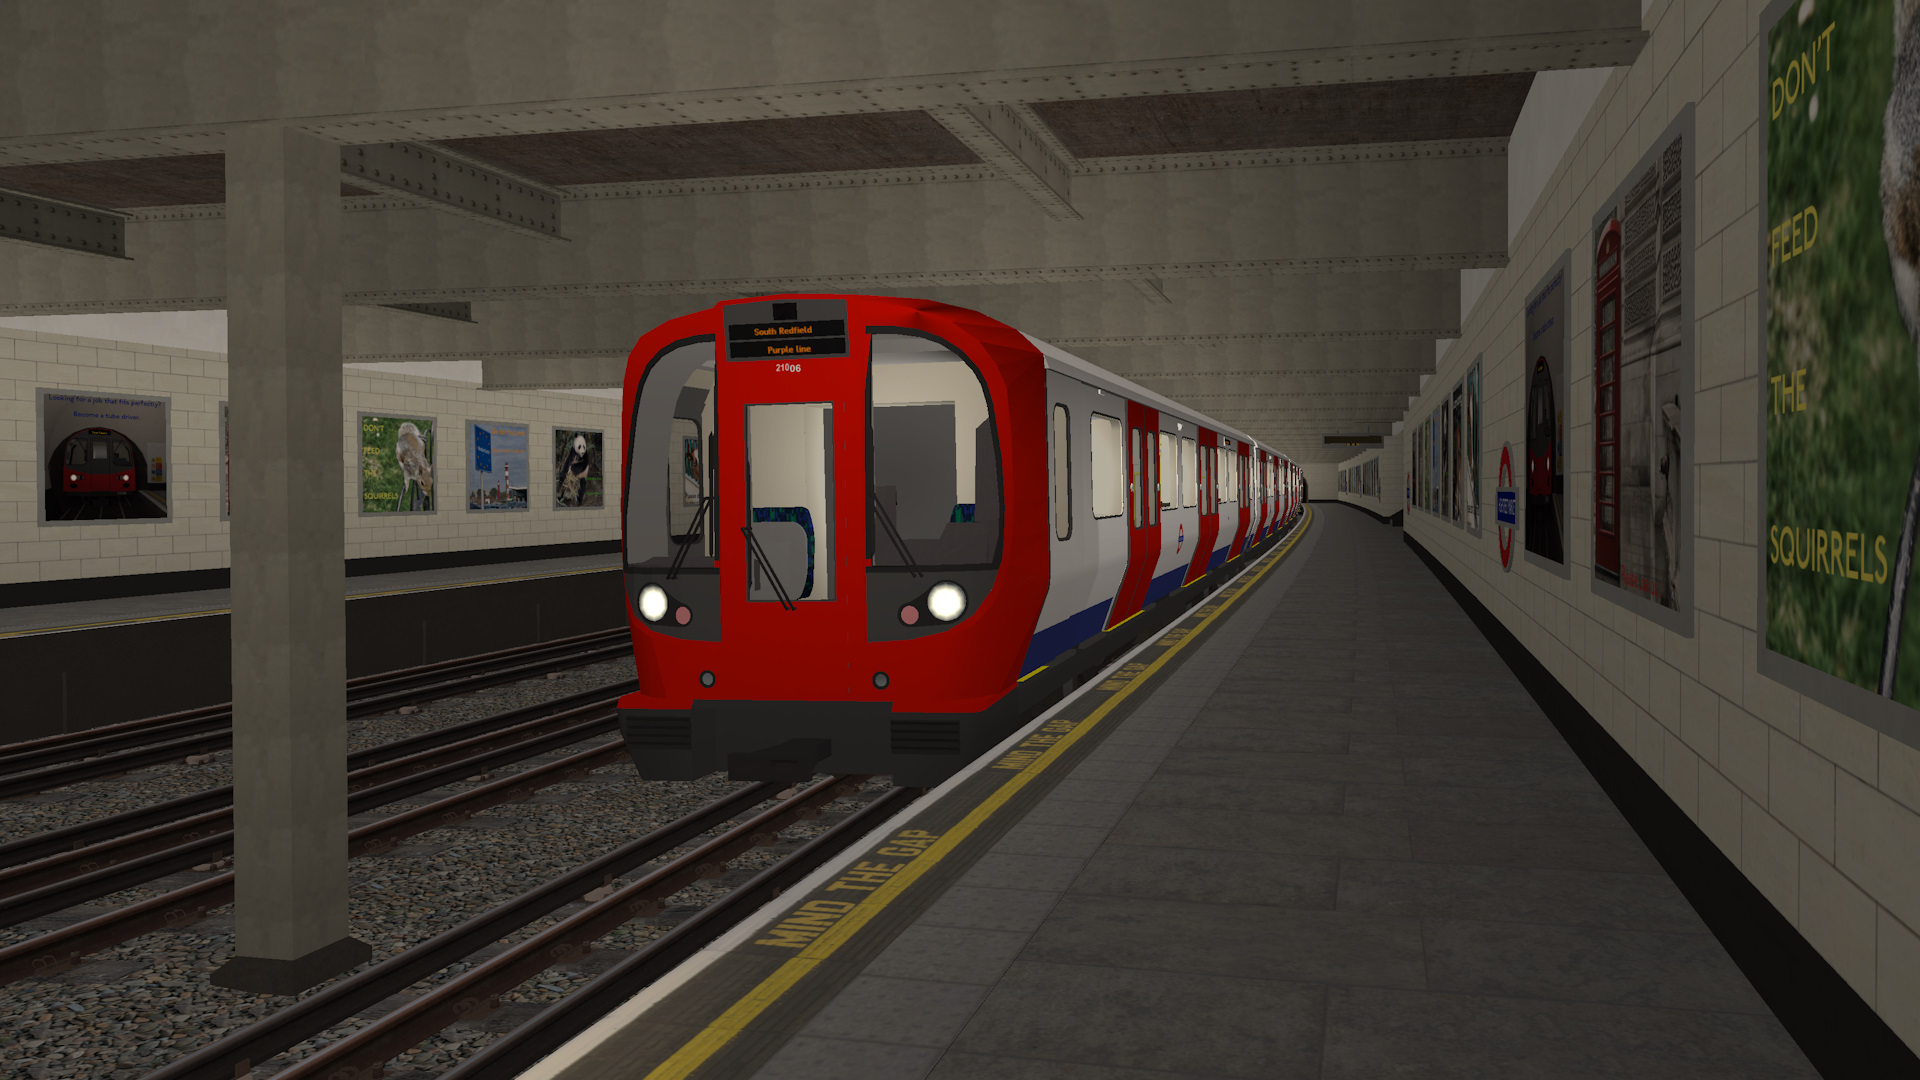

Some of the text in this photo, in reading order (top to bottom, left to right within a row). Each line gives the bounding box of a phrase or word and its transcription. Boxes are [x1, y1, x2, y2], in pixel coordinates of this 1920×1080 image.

[1772, 21, 1836, 121] DON'T
[1771, 205, 1818, 268] FEED
[754, 326, 812, 336] South Redfield
[767, 345, 812, 355] Purple line
[776, 363, 801, 373] 21006
[1770, 368, 1807, 416] THE
[48, 394, 74, 404] Looking
[131, 400, 161, 408] perfectly?
[490, 427, 499, 435] Go
[363, 447, 380, 455] FEED
[363, 469, 377, 477] THE
[363, 492, 399, 500] SQUIRRELS
[1770, 524, 1888, 584] SQUIRRELS
[1620, 564, 1638, 589] Please
[991, 719, 1080, 770] MIND THE GAP
[754, 829, 940, 949] MIND THE GAP
